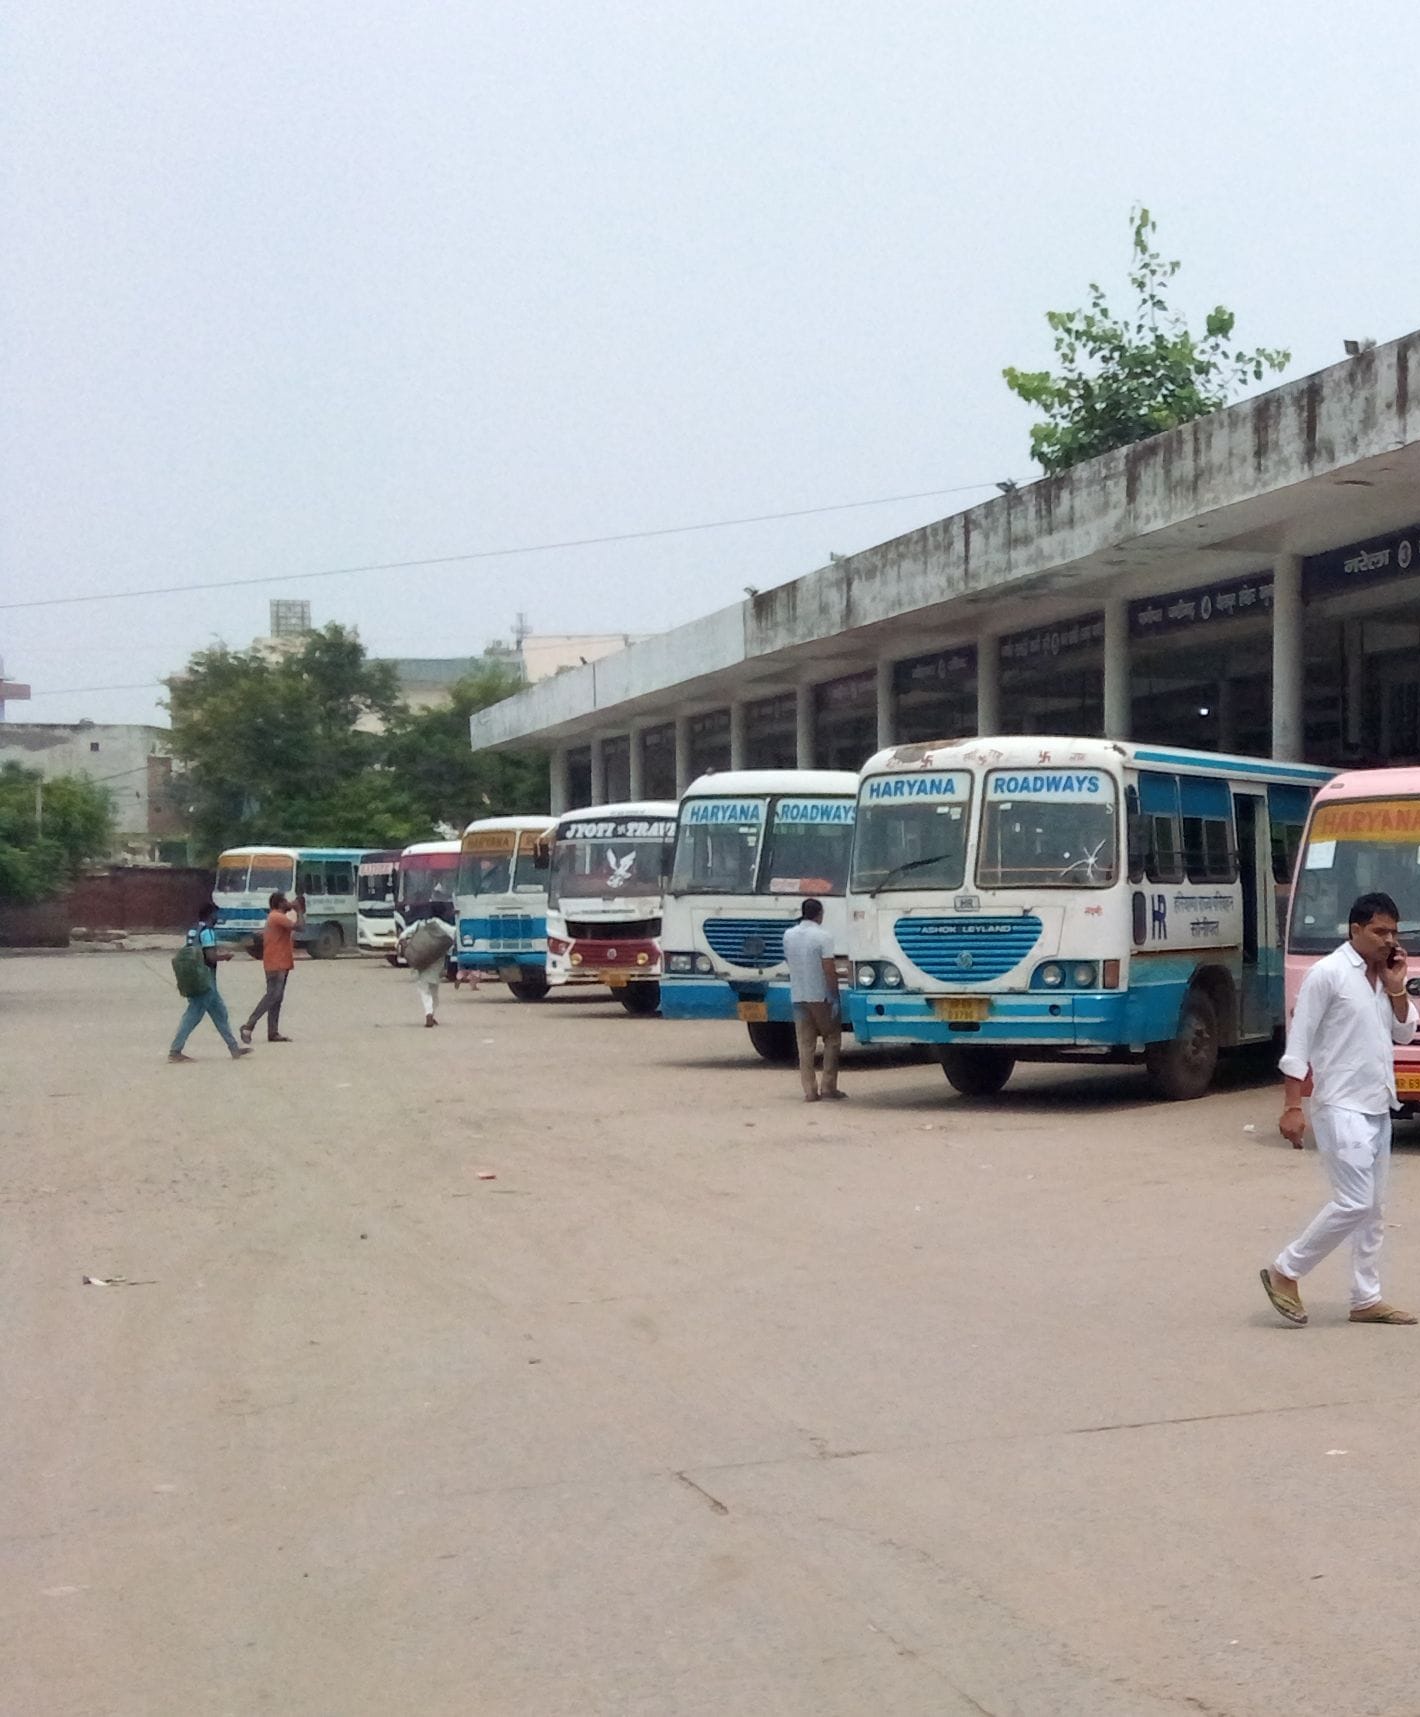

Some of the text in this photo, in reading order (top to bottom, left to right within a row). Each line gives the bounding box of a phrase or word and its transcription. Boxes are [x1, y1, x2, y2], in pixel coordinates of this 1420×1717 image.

[1343, 549, 1392, 574] नरेला
[868, 774, 1101, 799] HARYANA ROADWAYS
[689, 804, 761, 823] HARYANA
[564, 821, 617, 839] JYOTI
[920, 923, 1013, 935] ASHOK LEYLAND
